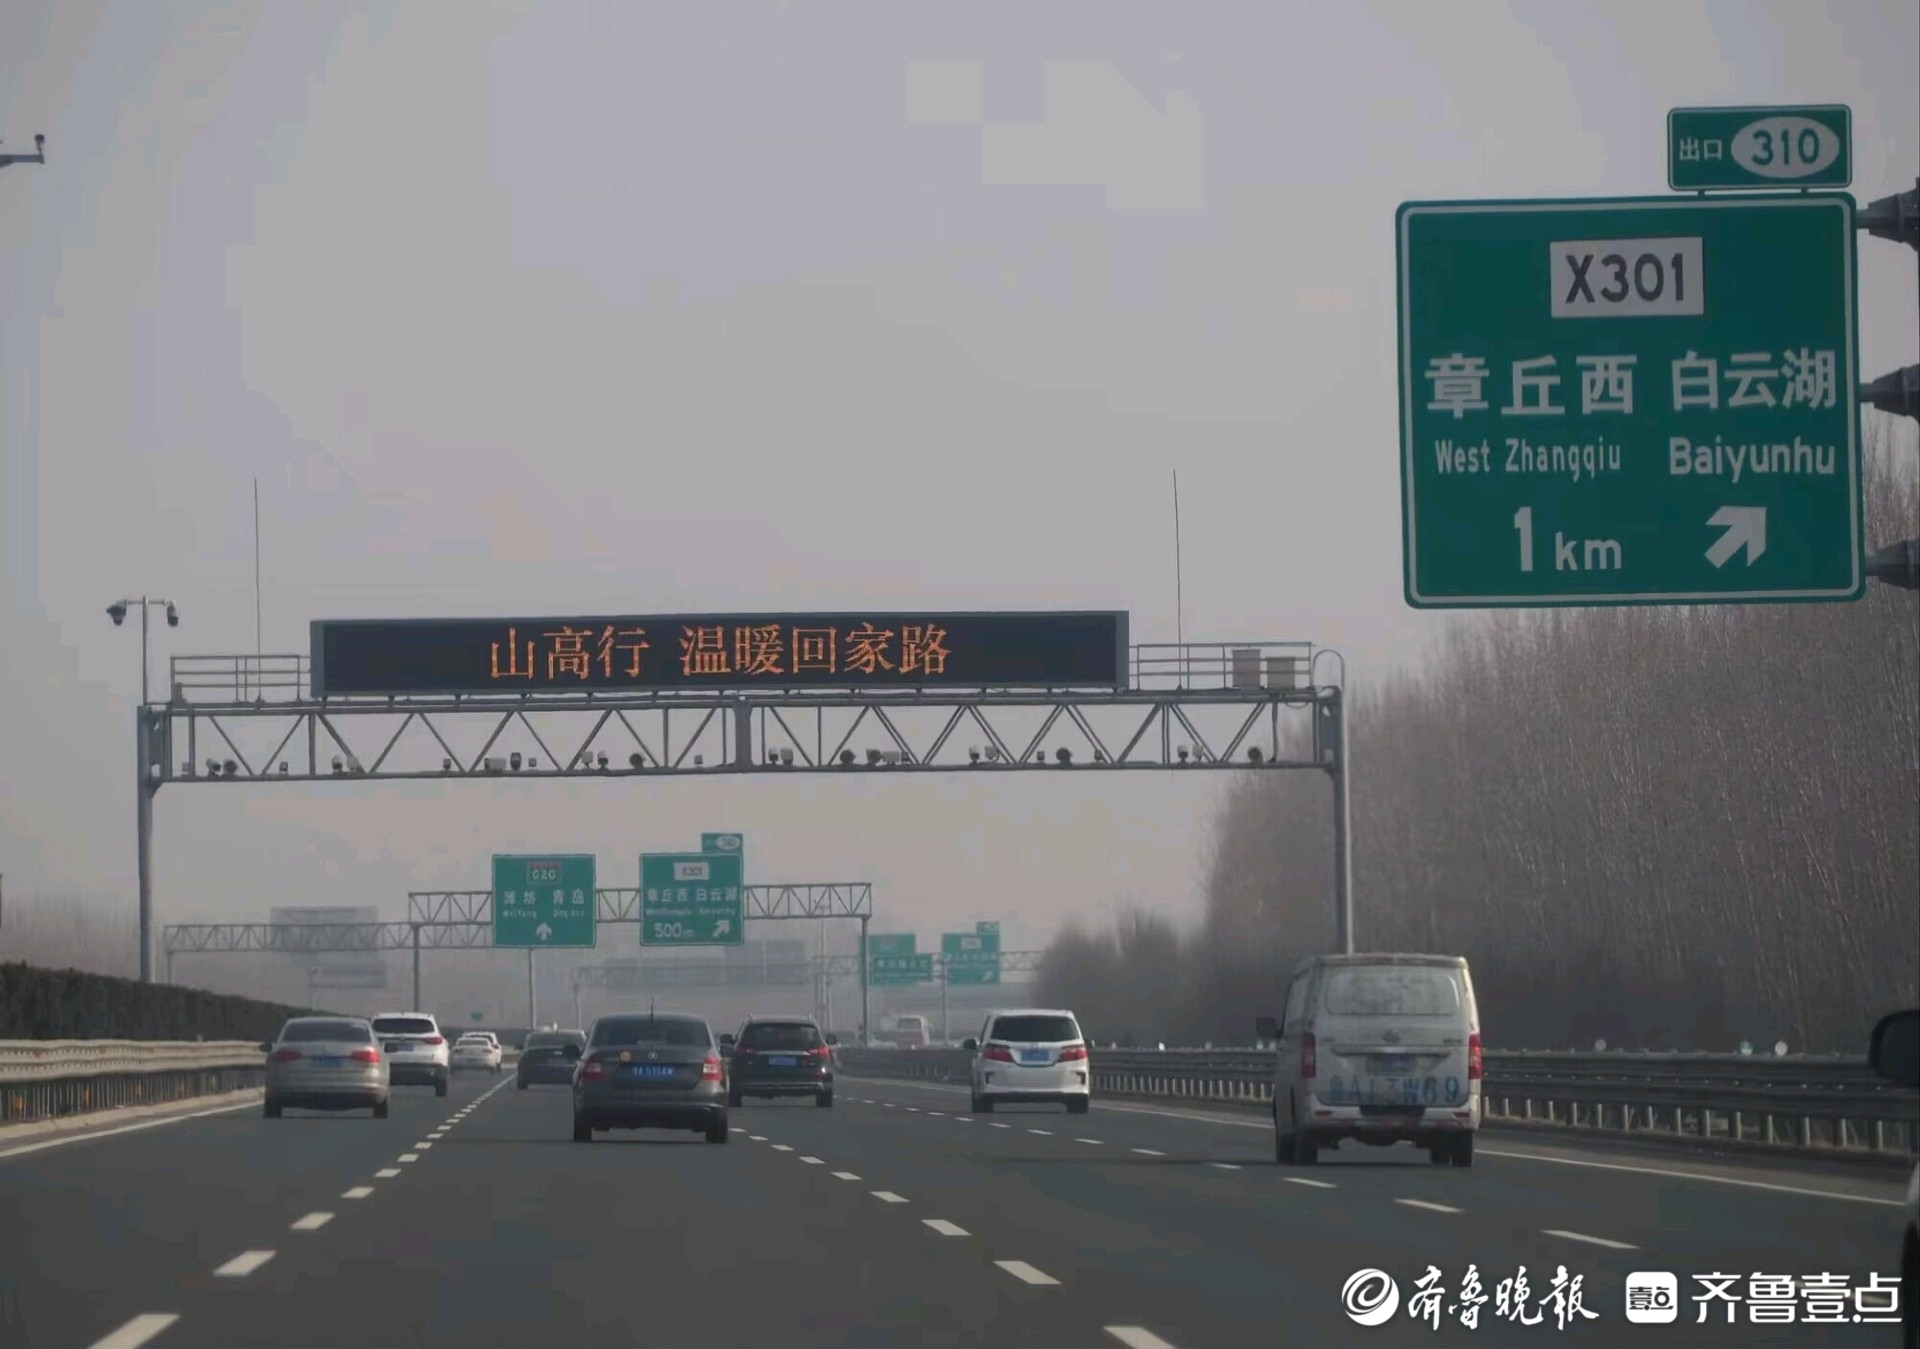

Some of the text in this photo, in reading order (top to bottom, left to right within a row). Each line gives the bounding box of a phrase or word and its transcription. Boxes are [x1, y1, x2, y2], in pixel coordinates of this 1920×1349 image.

[1679, 128, 1820, 166] 出口 310
[1564, 252, 1685, 304] X301
[1424, 347, 1837, 420] 章丘西 白云湖
[1435, 436, 1836, 483] West Zhangqiu Baiyunhu
[1513, 506, 1622, 572] 1 km
[490, 622, 952, 681] 山高行 温暖回家路
[654, 922, 683, 938] 500
